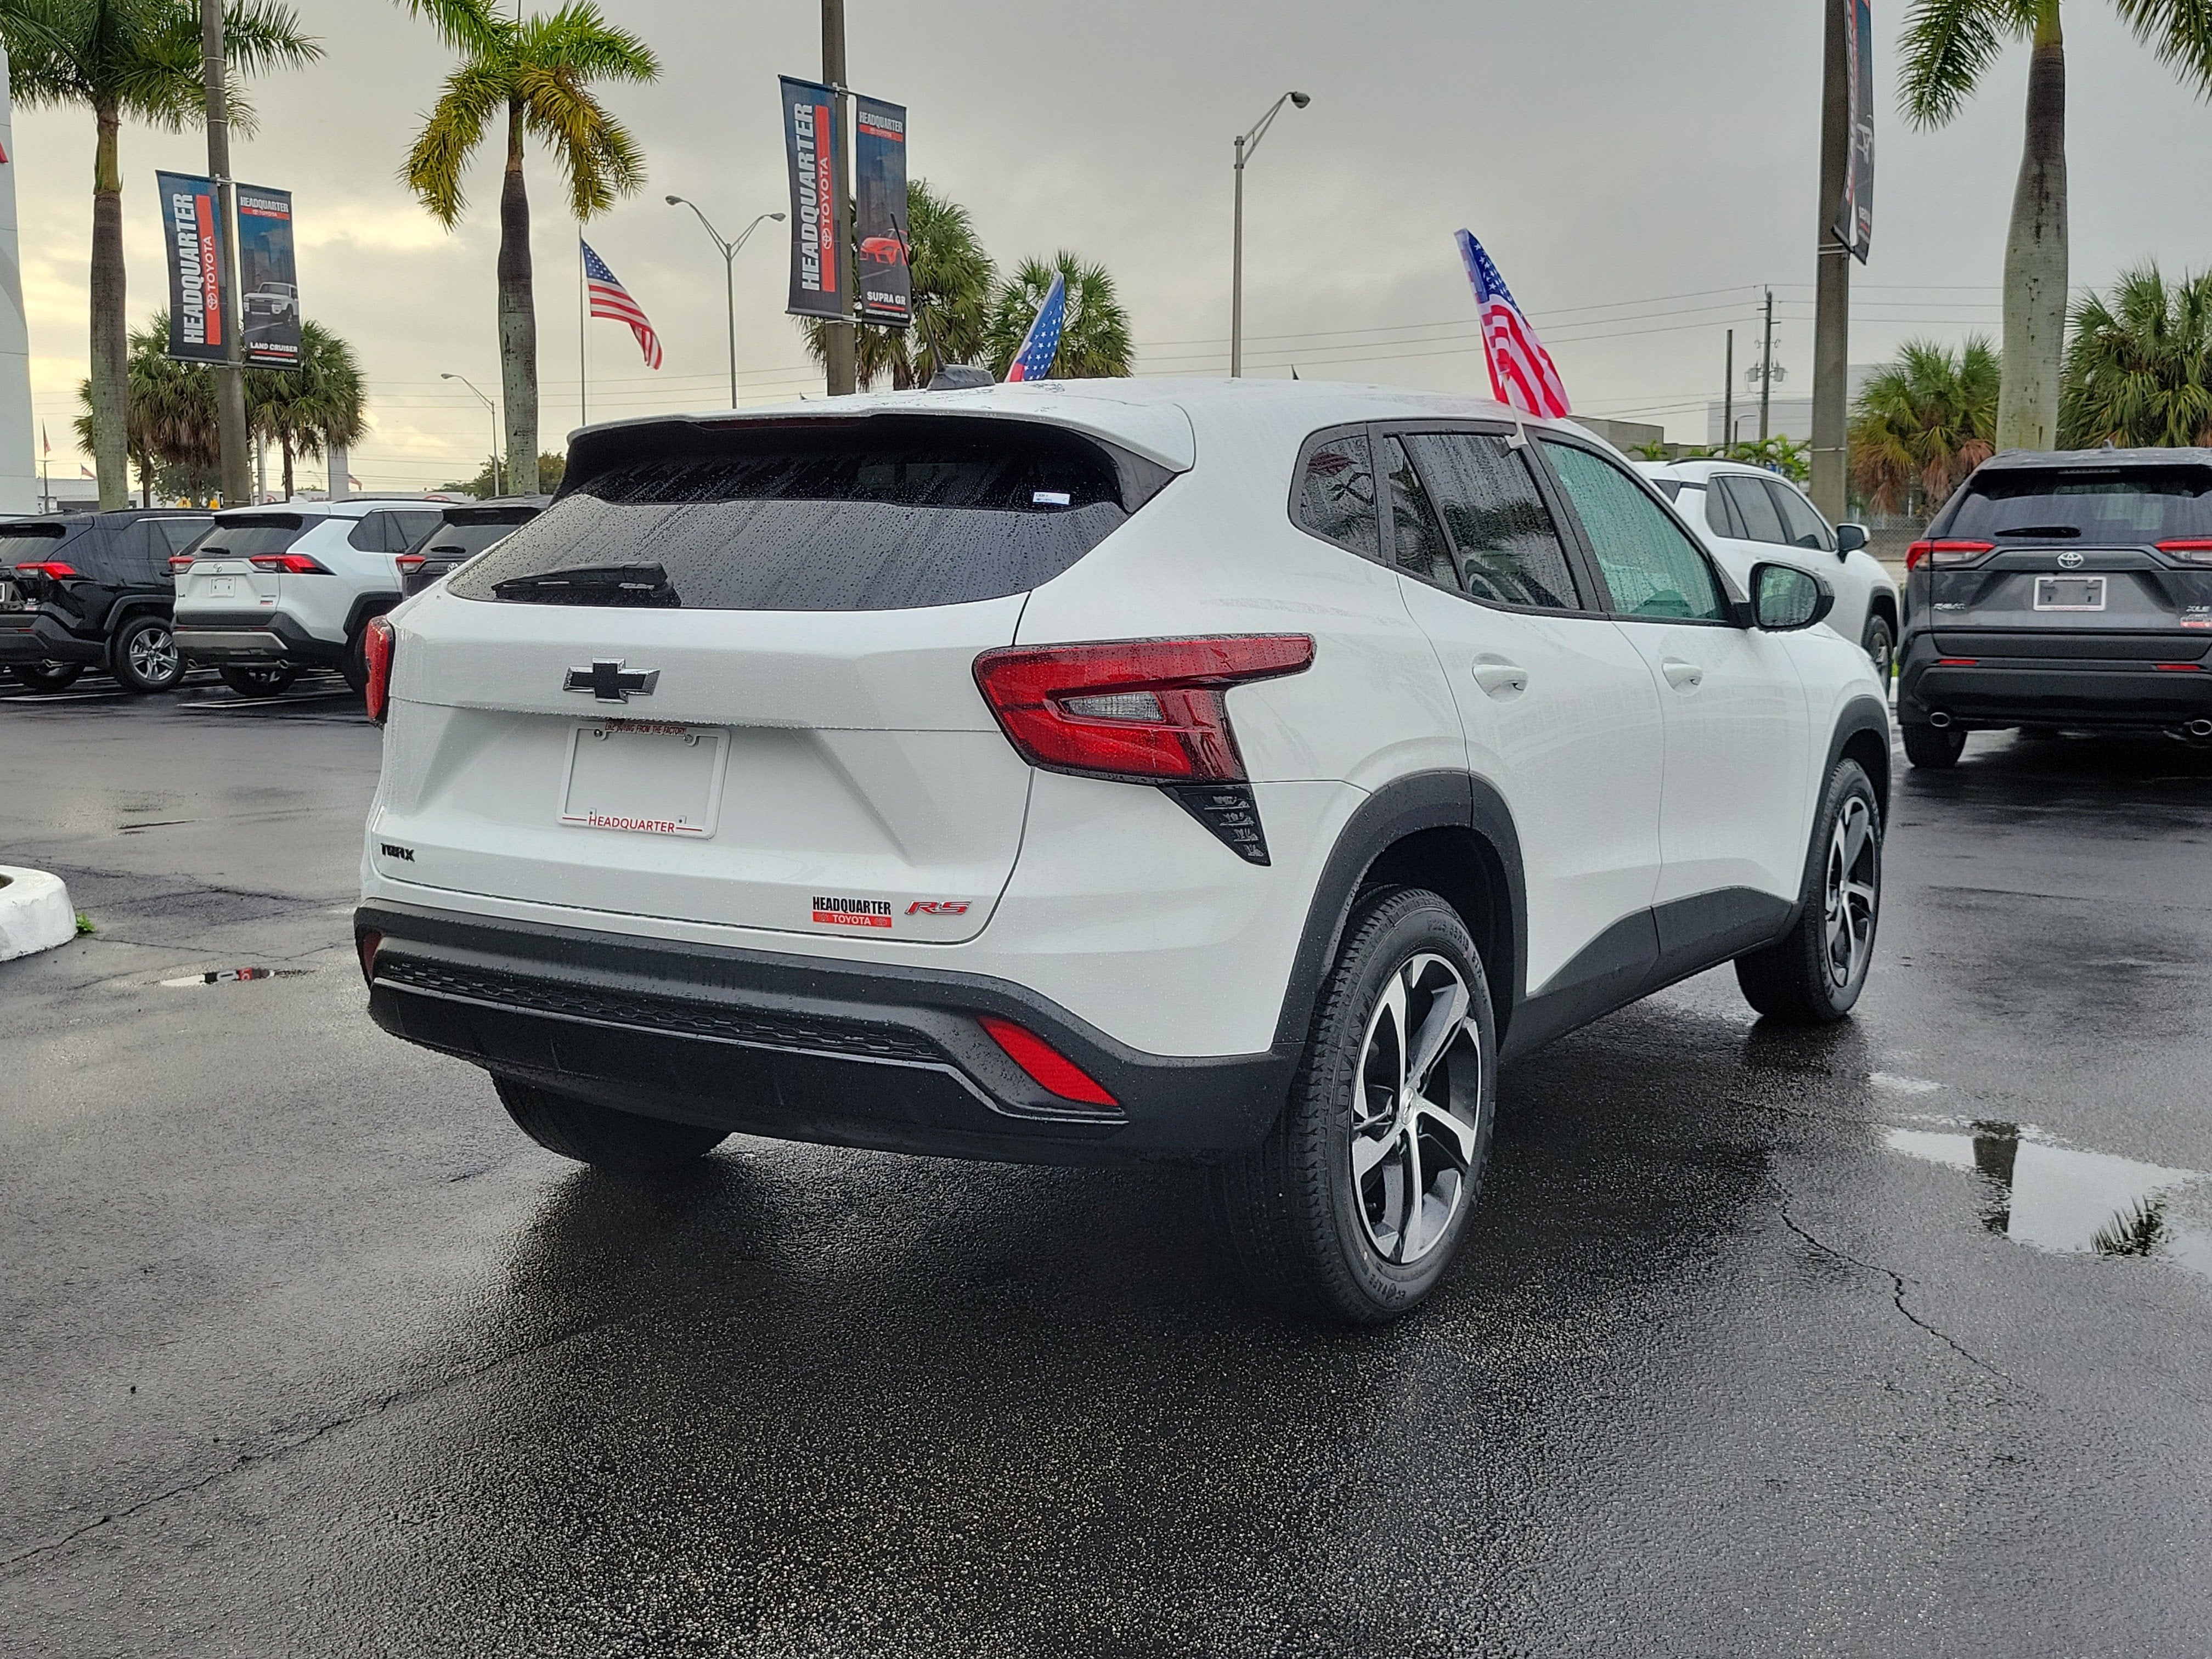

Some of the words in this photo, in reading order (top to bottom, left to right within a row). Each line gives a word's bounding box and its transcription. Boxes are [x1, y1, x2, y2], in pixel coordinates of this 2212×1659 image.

[859, 111, 903, 133] HEADQUARTER
[794, 103, 820, 291] HEADQUARTER
[820, 157, 831, 226] TOYOTA
[240, 196, 289, 213] HEADQUARTER
[173, 193, 205, 344] HEADQUARTER
[204, 236, 217, 290] TOYOTA
[867, 291, 894, 303] SUPRA
[895, 295, 906, 305] GR
[269, 343, 297, 353] CRUISER
[636, 725, 651, 733] FROM
[653, 725, 662, 734] THE
[589, 816, 675, 832] HEADQUARTER
[812, 896, 891, 915] HEADQUARTER
[904, 900, 972, 915] RS
[833, 916, 871, 926] TOYOTA
